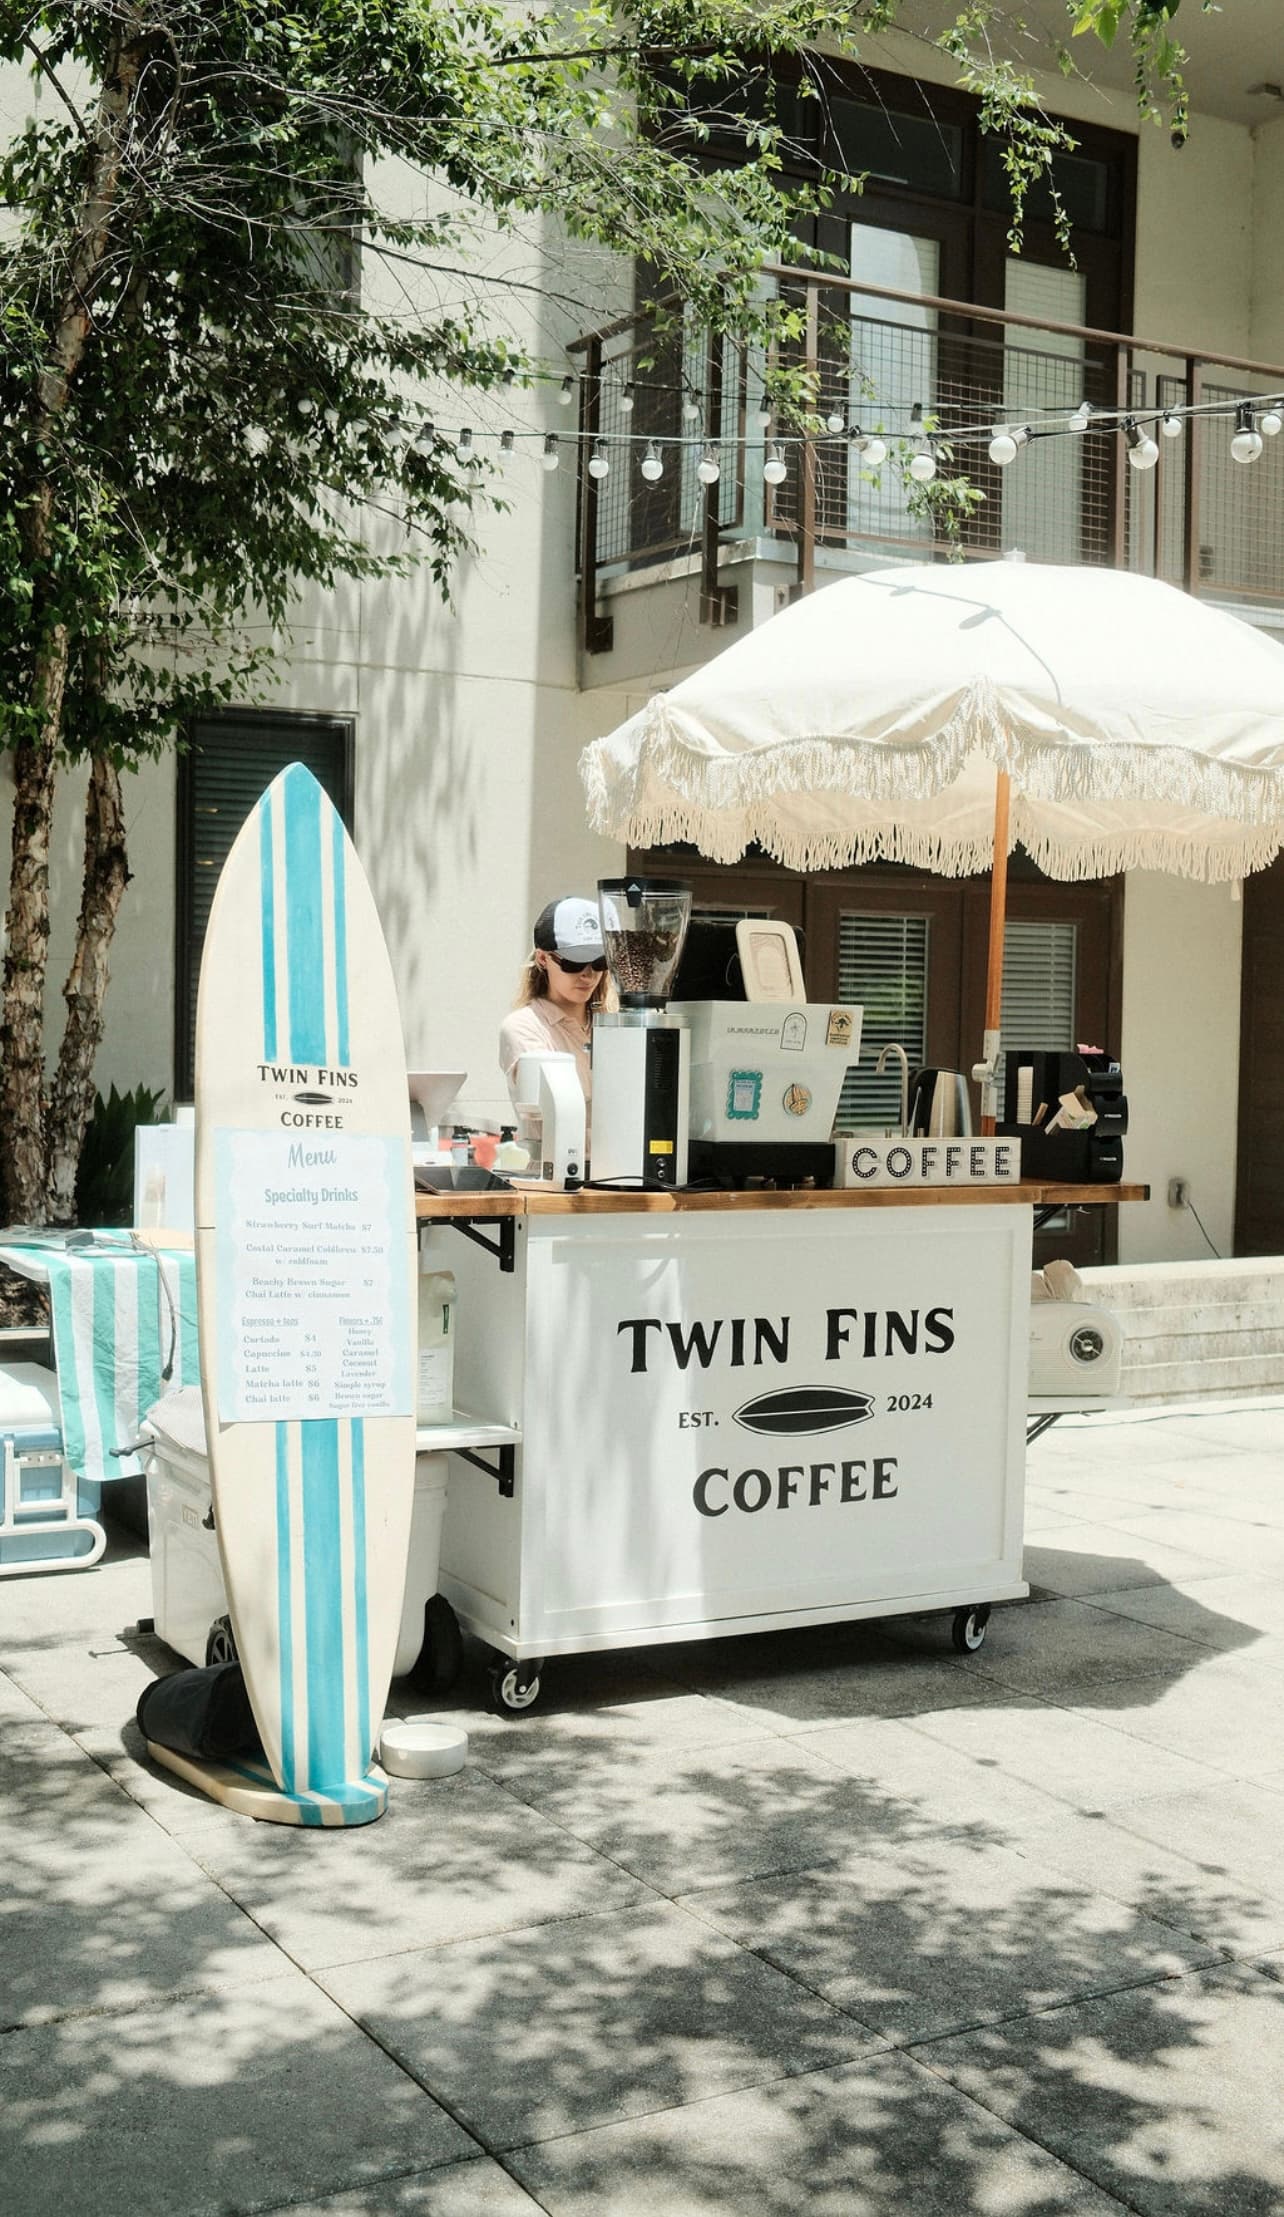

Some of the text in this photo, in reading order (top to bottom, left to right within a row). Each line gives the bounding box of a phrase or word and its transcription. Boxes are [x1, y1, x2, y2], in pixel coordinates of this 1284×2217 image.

[257, 1065, 359, 1088] TWIN FINS
[280, 1111, 344, 1129] COFFEE
[287, 1141, 337, 1169] Menu
[852, 1146, 1011, 1179] COFFEE
[264, 1187, 360, 1206] Specialty Drinks
[245, 1220, 298, 1231] Strawberry
[276, 1244, 315, 1254] Caramel
[287, 1278, 318, 1287] Brown
[319, 1278, 346, 1288] Sugar
[245, 1290, 267, 1299] Chai
[269, 1290, 293, 1299] Latte
[617, 1307, 955, 1373] TWIN FINS
[245, 1364, 271, 1373] Latte
[246, 1379, 281, 1388] Matcha
[282, 1379, 304, 1388] latte
[245, 1394, 267, 1403] Chai
[886, 1394, 934, 1413] 2024
[678, 1411, 720, 1429] EST.
[692, 1457, 899, 1518] COFFEE
